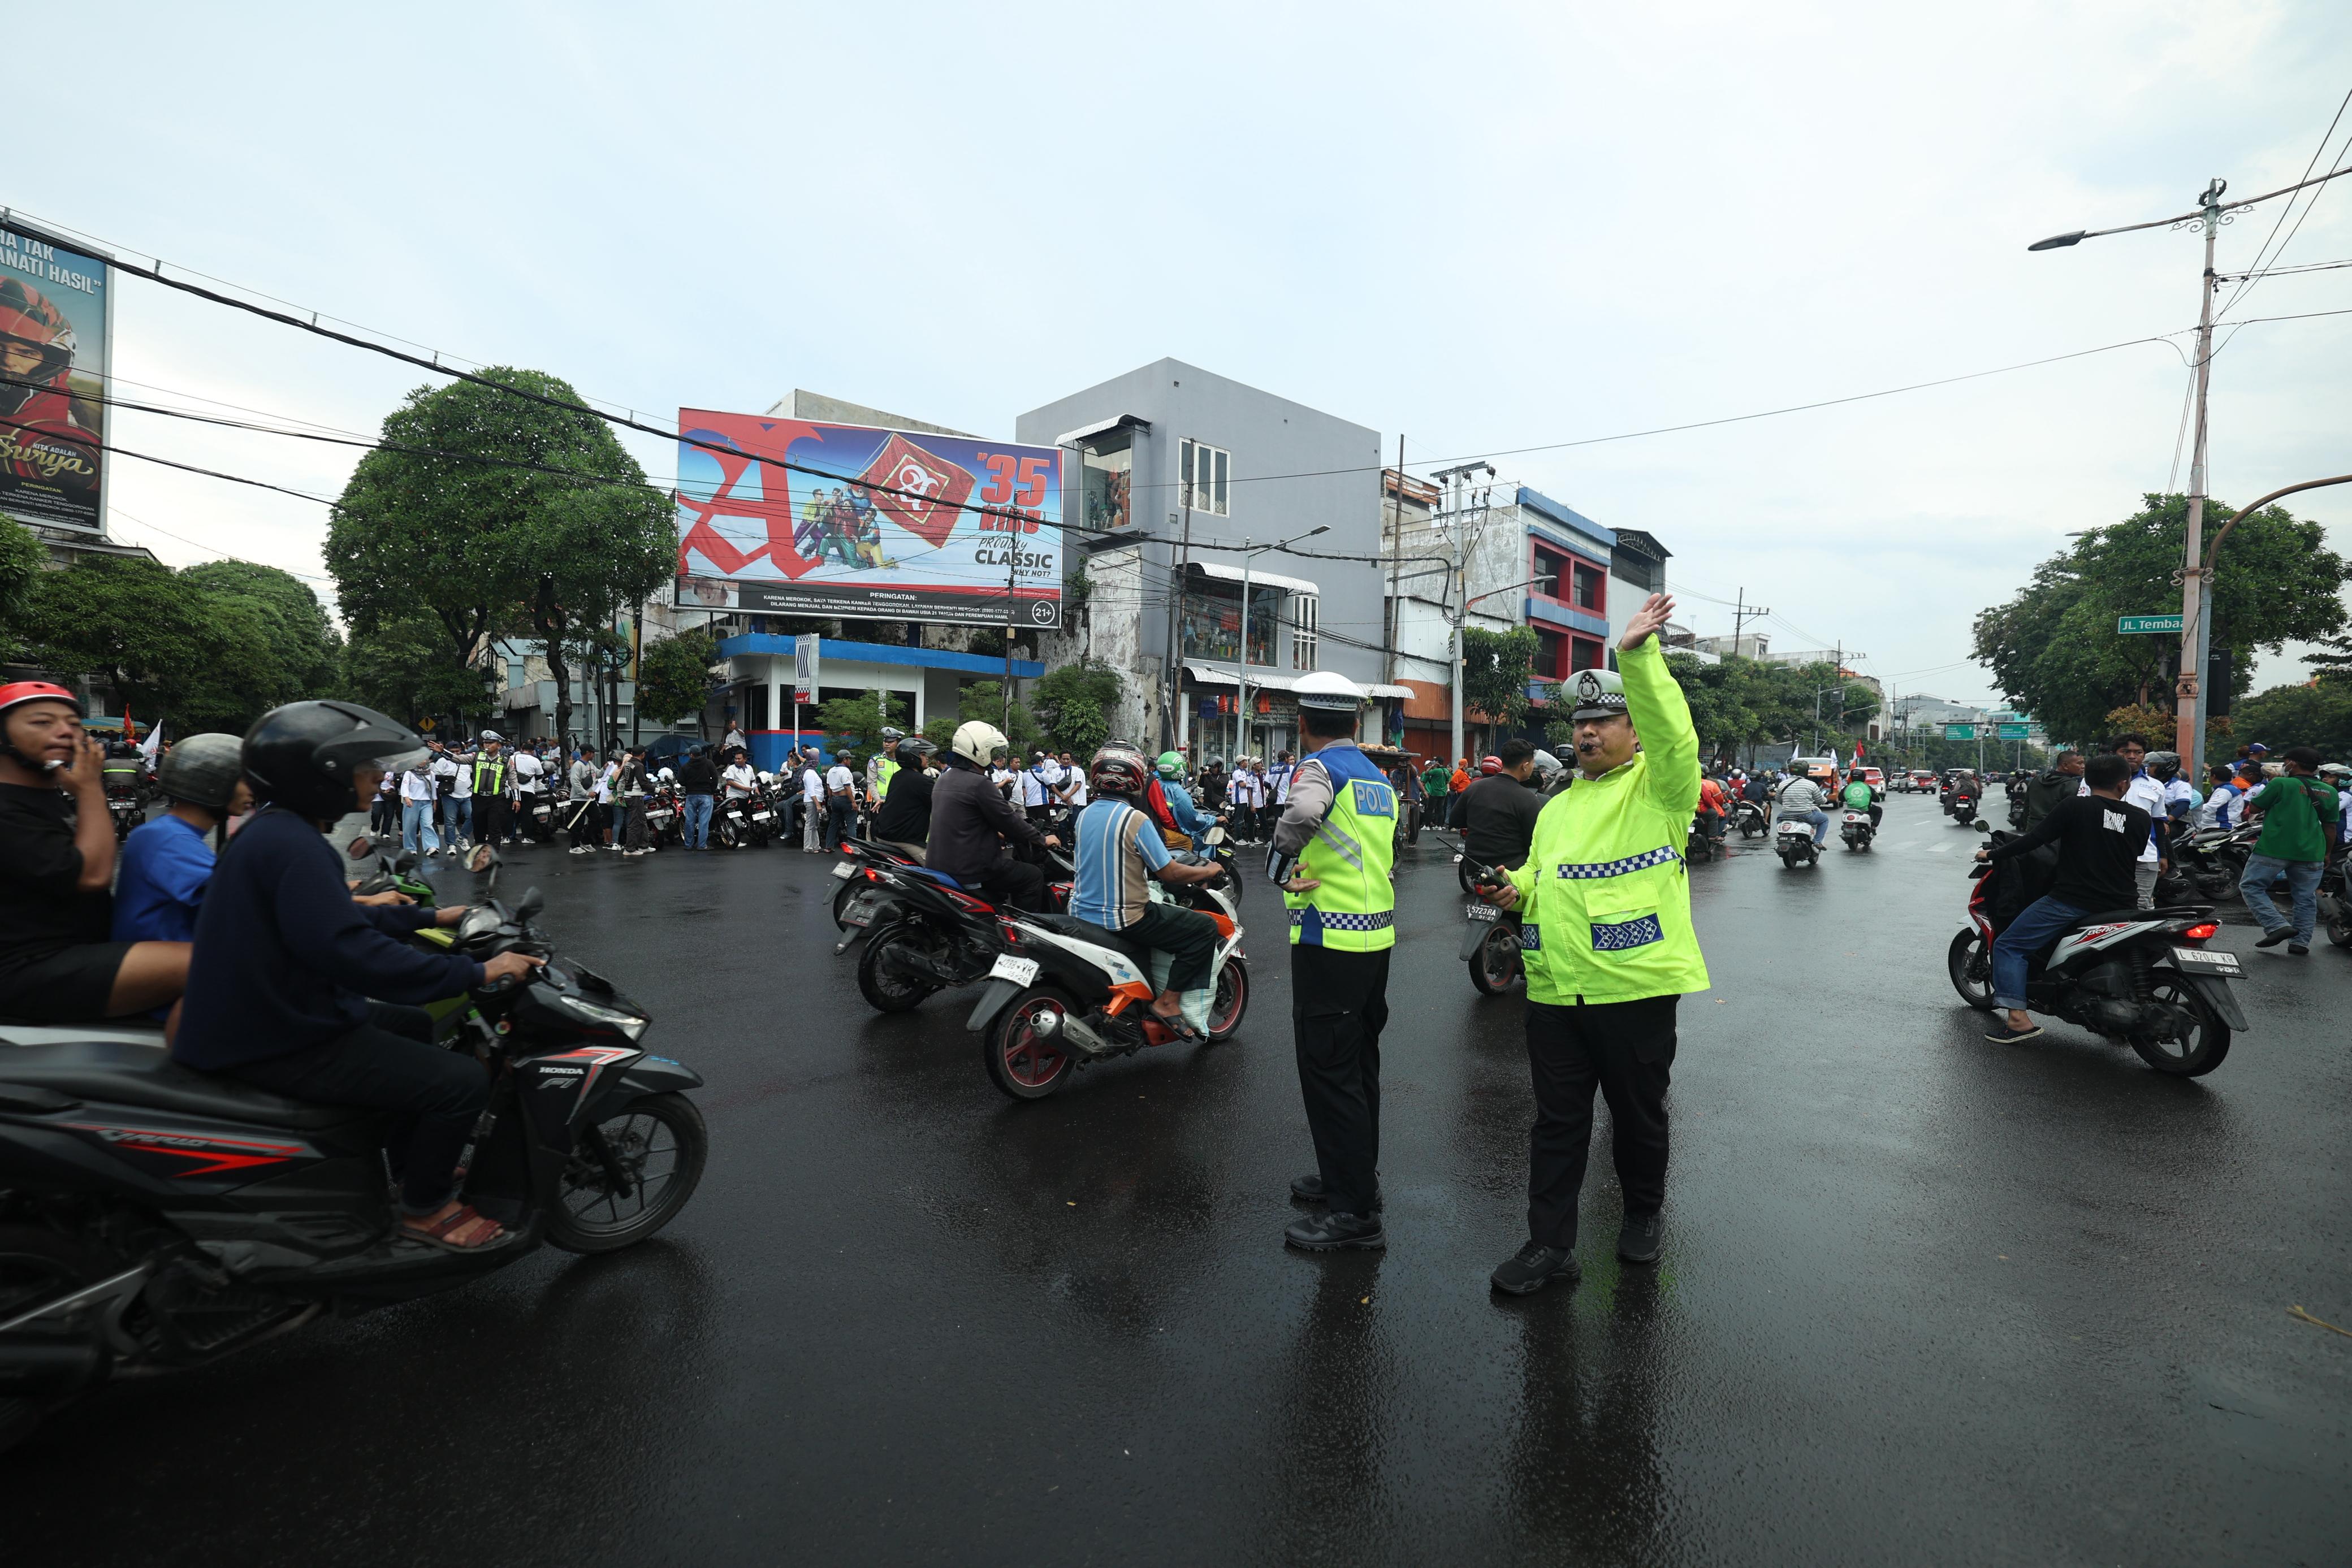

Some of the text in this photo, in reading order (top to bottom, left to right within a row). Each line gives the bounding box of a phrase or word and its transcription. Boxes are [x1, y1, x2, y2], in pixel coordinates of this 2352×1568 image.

[23, 237, 54, 262] TAK
[0, 435, 94, 477] Surya
[33, 443, 77, 457] KITA ADALAH
[21, 482, 63, 493] PERINGATAN:
[980, 454, 1050, 508] 35
[2, 491, 29, 500] TERKENA
[979, 505, 1041, 534] RIBU
[975, 549, 1053, 569] CLASSIC
[870, 592, 917, 601] PERINGATAN:
[1035, 608, 1052, 617] 21+
[1471, 906, 1488, 915] 5723
[2178, 950, 2235, 964] L 6204 KR
